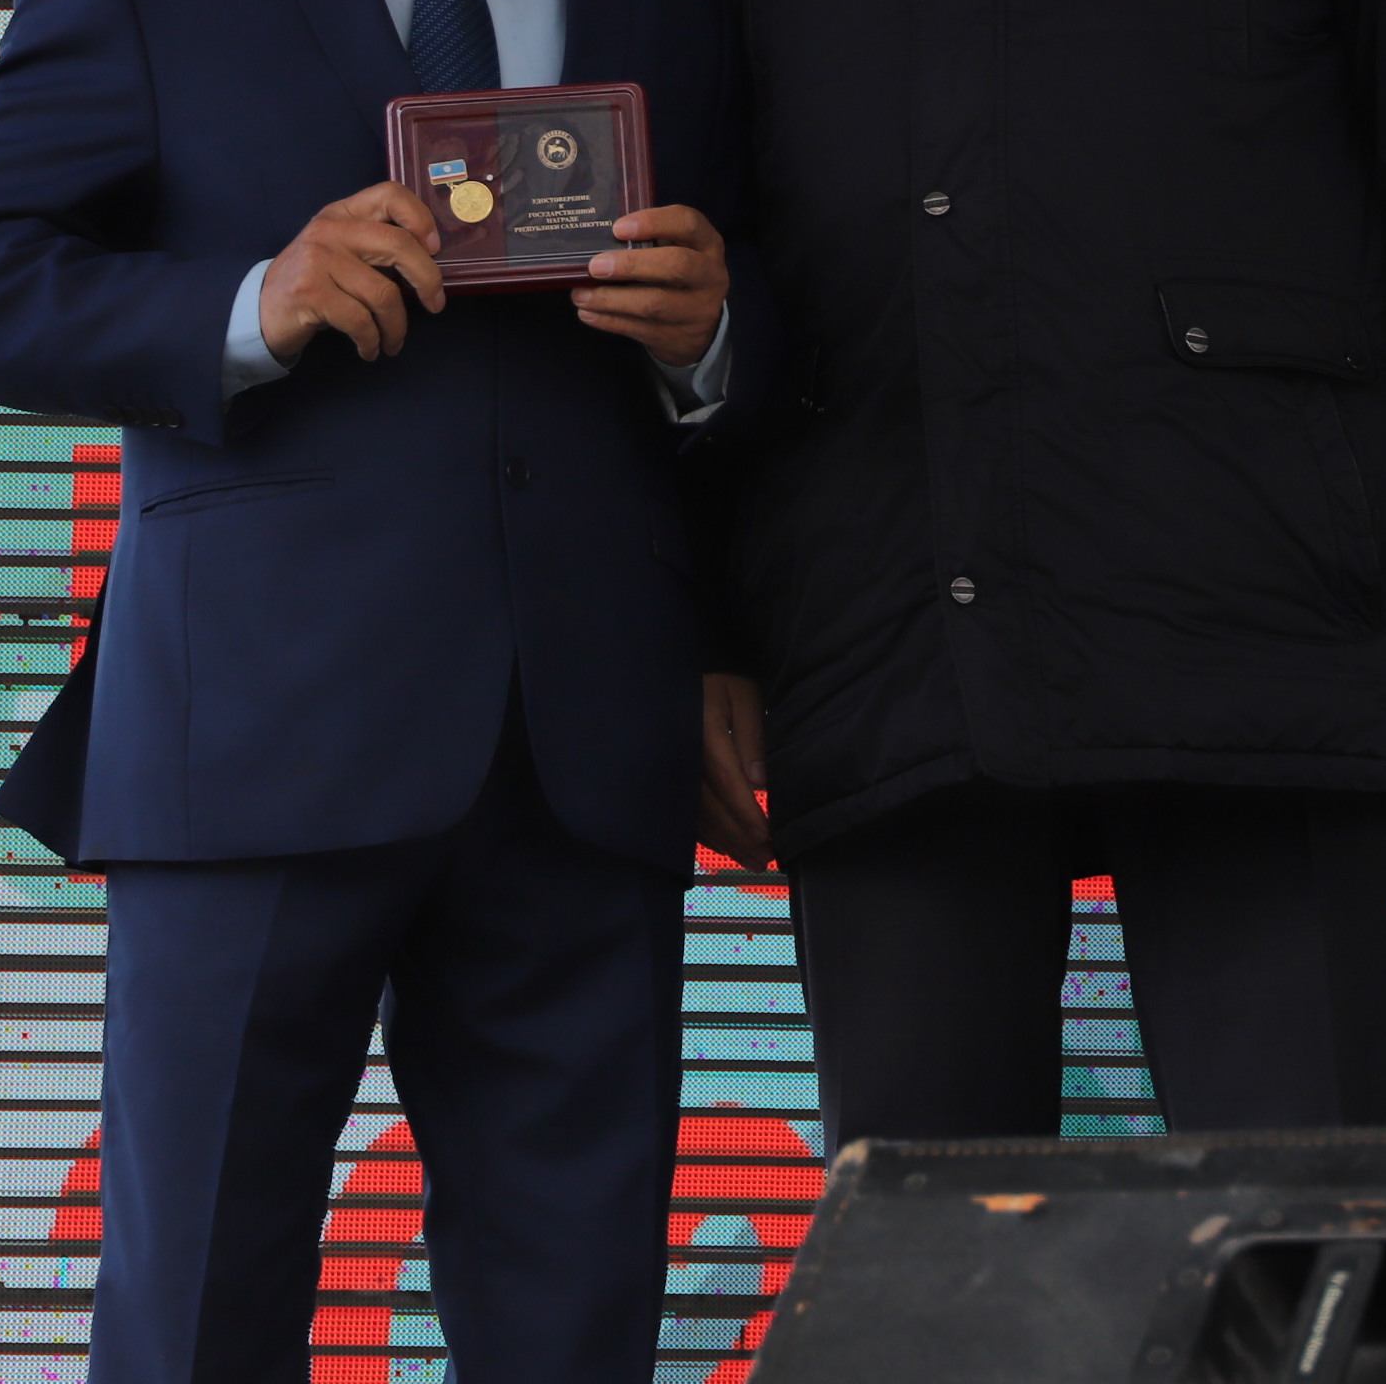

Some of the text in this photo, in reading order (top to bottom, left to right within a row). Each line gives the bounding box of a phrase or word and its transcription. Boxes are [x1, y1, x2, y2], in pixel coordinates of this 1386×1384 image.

[532, 194, 591, 205] УДОСТОВЕРЕНИЕ
[528, 207, 596, 218] ГОСУДАРСТВЕННОЙ
[546, 216, 579, 224] НАГРАДЕ
[514, 220, 613, 233] РЕСПУБЛИКИ САХА (ЯКУТИЯ)
